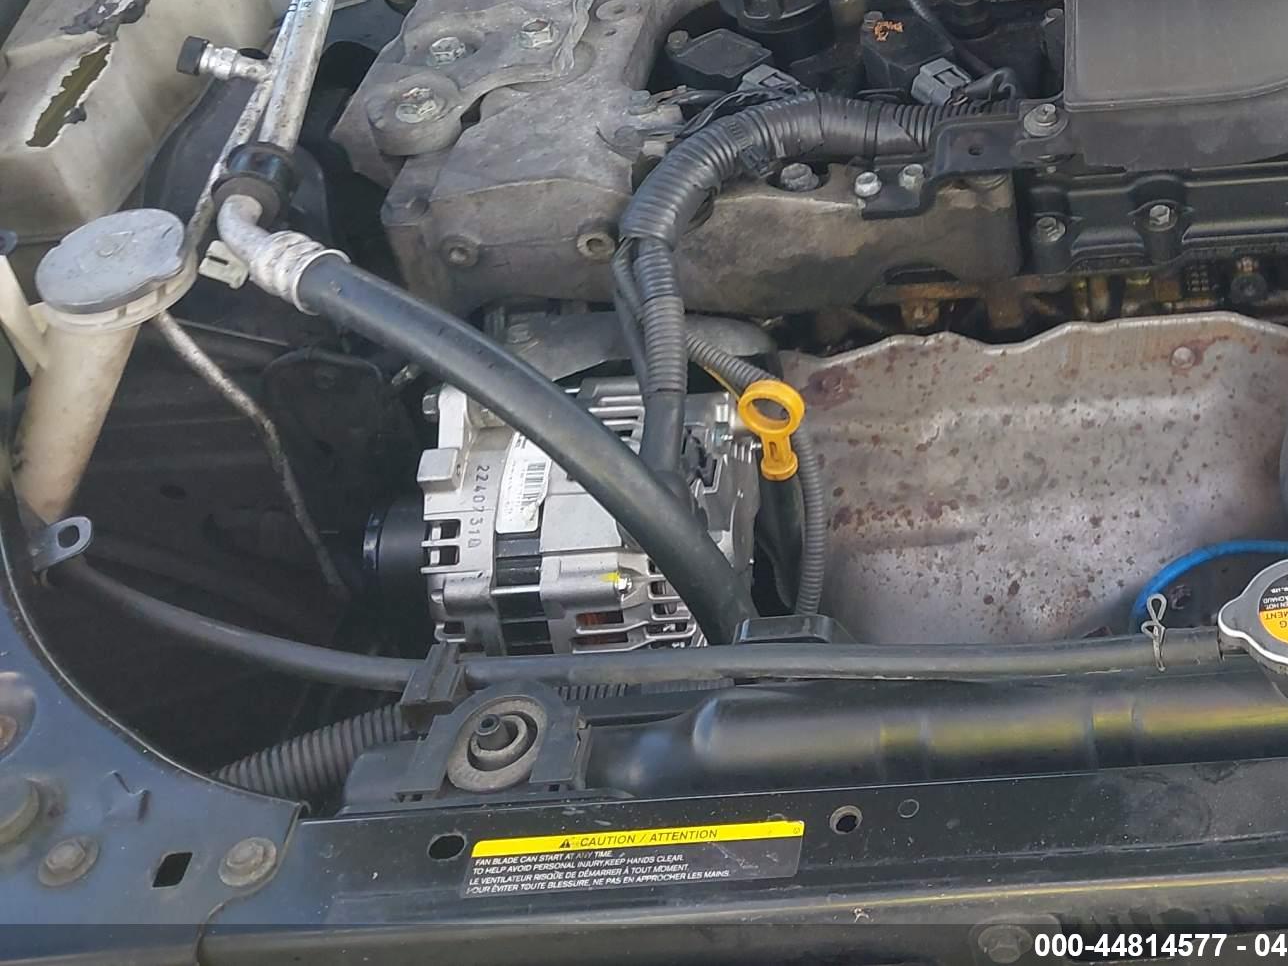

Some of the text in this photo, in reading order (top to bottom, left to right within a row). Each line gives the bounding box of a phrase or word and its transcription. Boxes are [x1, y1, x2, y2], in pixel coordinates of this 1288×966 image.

[580, 835, 636, 847] CAUTION
[648, 829, 718, 843] ATTENTION
[473, 867, 484, 875] TO
[485, 865, 507, 874] HELP
[507, 864, 532, 872] AVOID
[532, 862, 576, 871] PERSONAL
[626, 856, 655, 865] HANDS
[475, 858, 492, 866] FAN
[492, 857, 519, 865] BLADE
[520, 855, 538, 863] CAN
[538, 854, 562, 862] START
[469, 878, 479, 886] LE
[481, 874, 532, 885] VENTILATEUR
[533, 872, 564, 881] RISQUE
[565, 871, 577, 879] DE
[577, 867, 622, 878] DÉMARRER
[631, 866, 653, 874] TOUT
[492, 883, 519, 893] ÉVITER
[520, 882, 547, 891] TOUTE
[593, 878, 605, 886] NE
[606, 877, 622, 885] PAS
[635, 872, 688, 882] APPROCHER
[688, 872, 703, 880] LES
